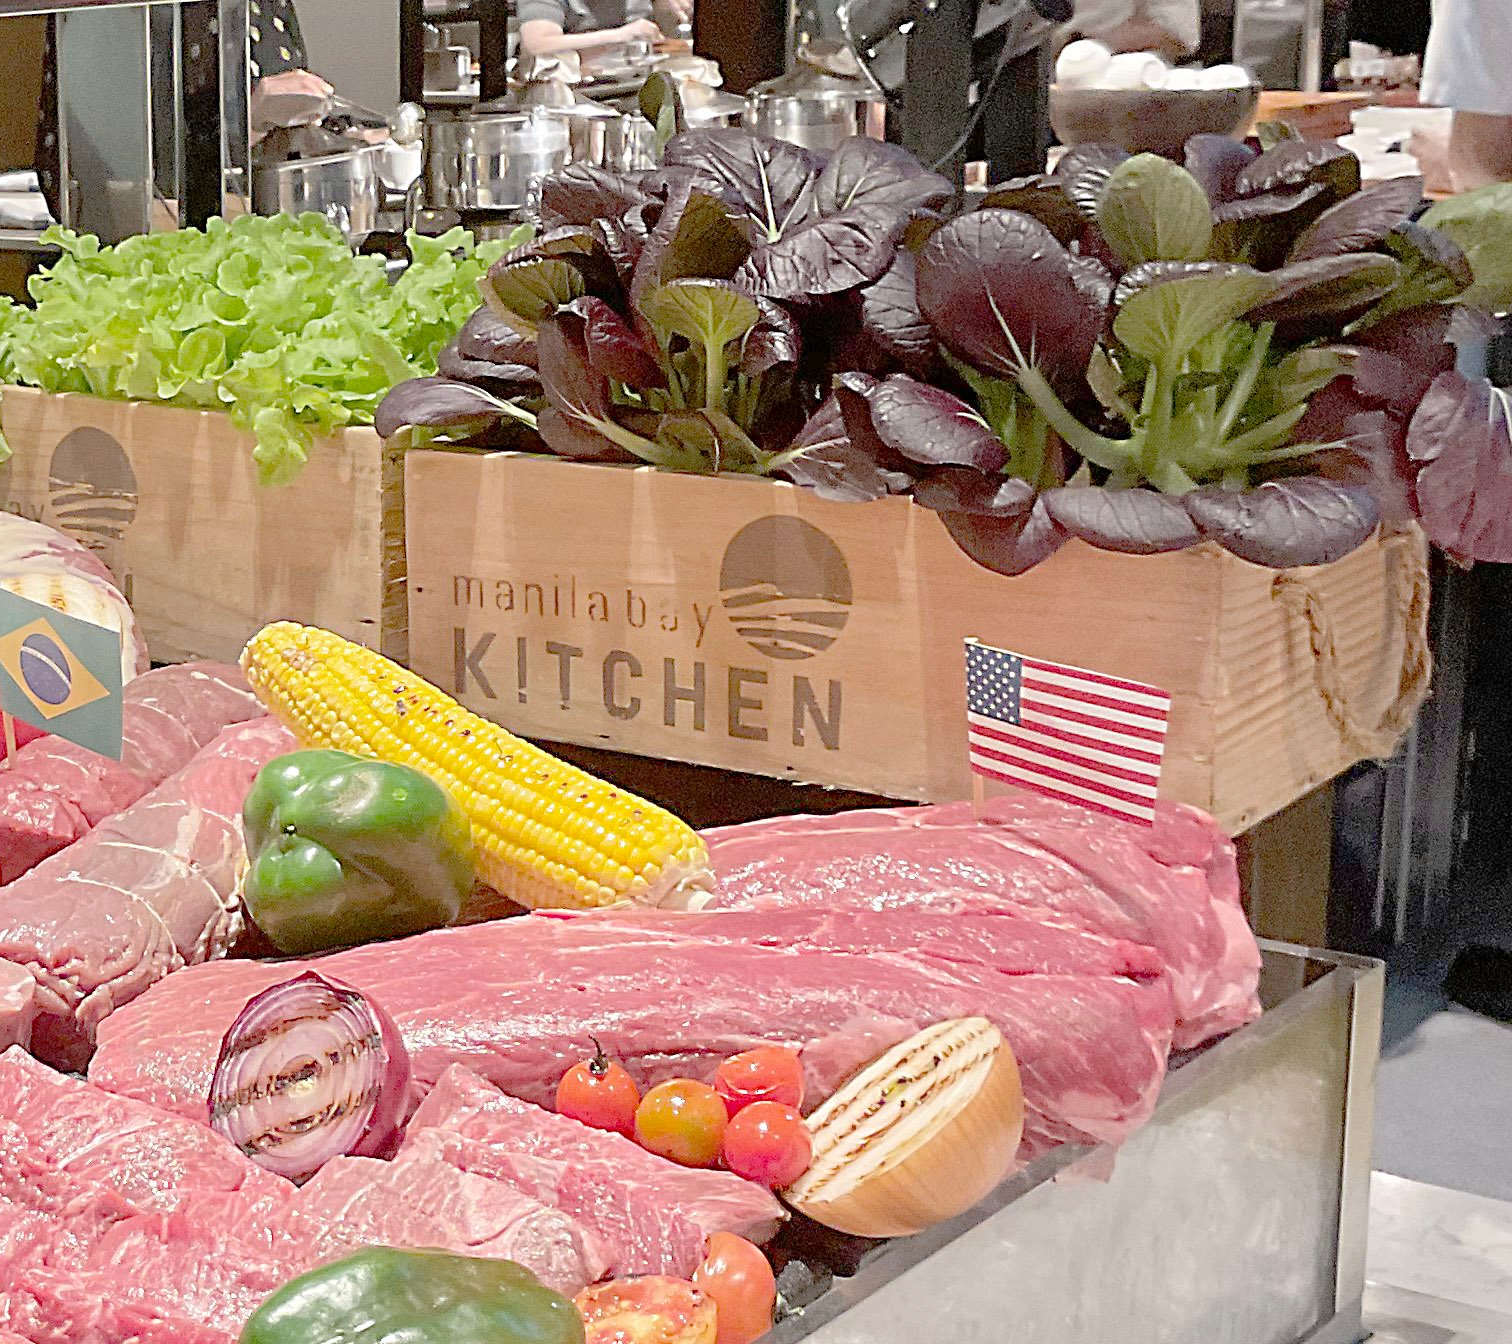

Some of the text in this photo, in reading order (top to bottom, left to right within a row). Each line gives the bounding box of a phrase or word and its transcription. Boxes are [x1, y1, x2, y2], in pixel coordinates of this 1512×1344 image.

[453, 573, 713, 648] manila bay
[454, 627, 841, 750] KITCHEN
